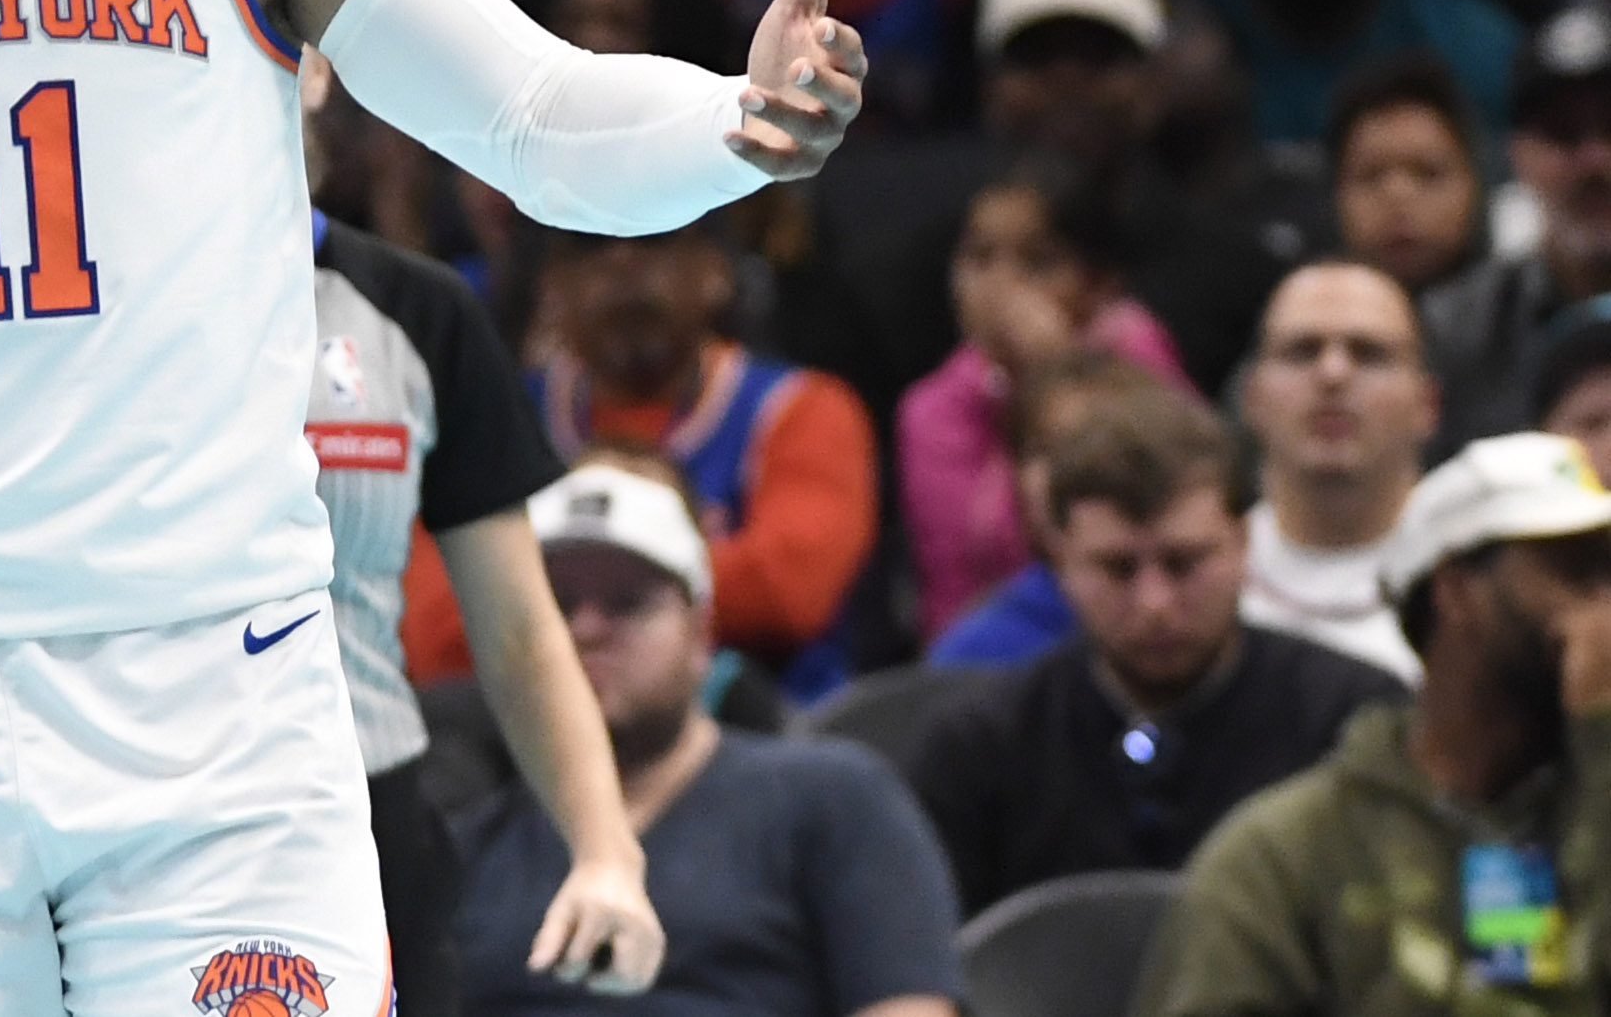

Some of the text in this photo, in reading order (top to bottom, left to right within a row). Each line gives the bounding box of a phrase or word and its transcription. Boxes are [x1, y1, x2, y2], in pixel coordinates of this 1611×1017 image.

[235, 939, 292, 956] NEW YORK
[192, 949, 329, 1014] KNICKS
